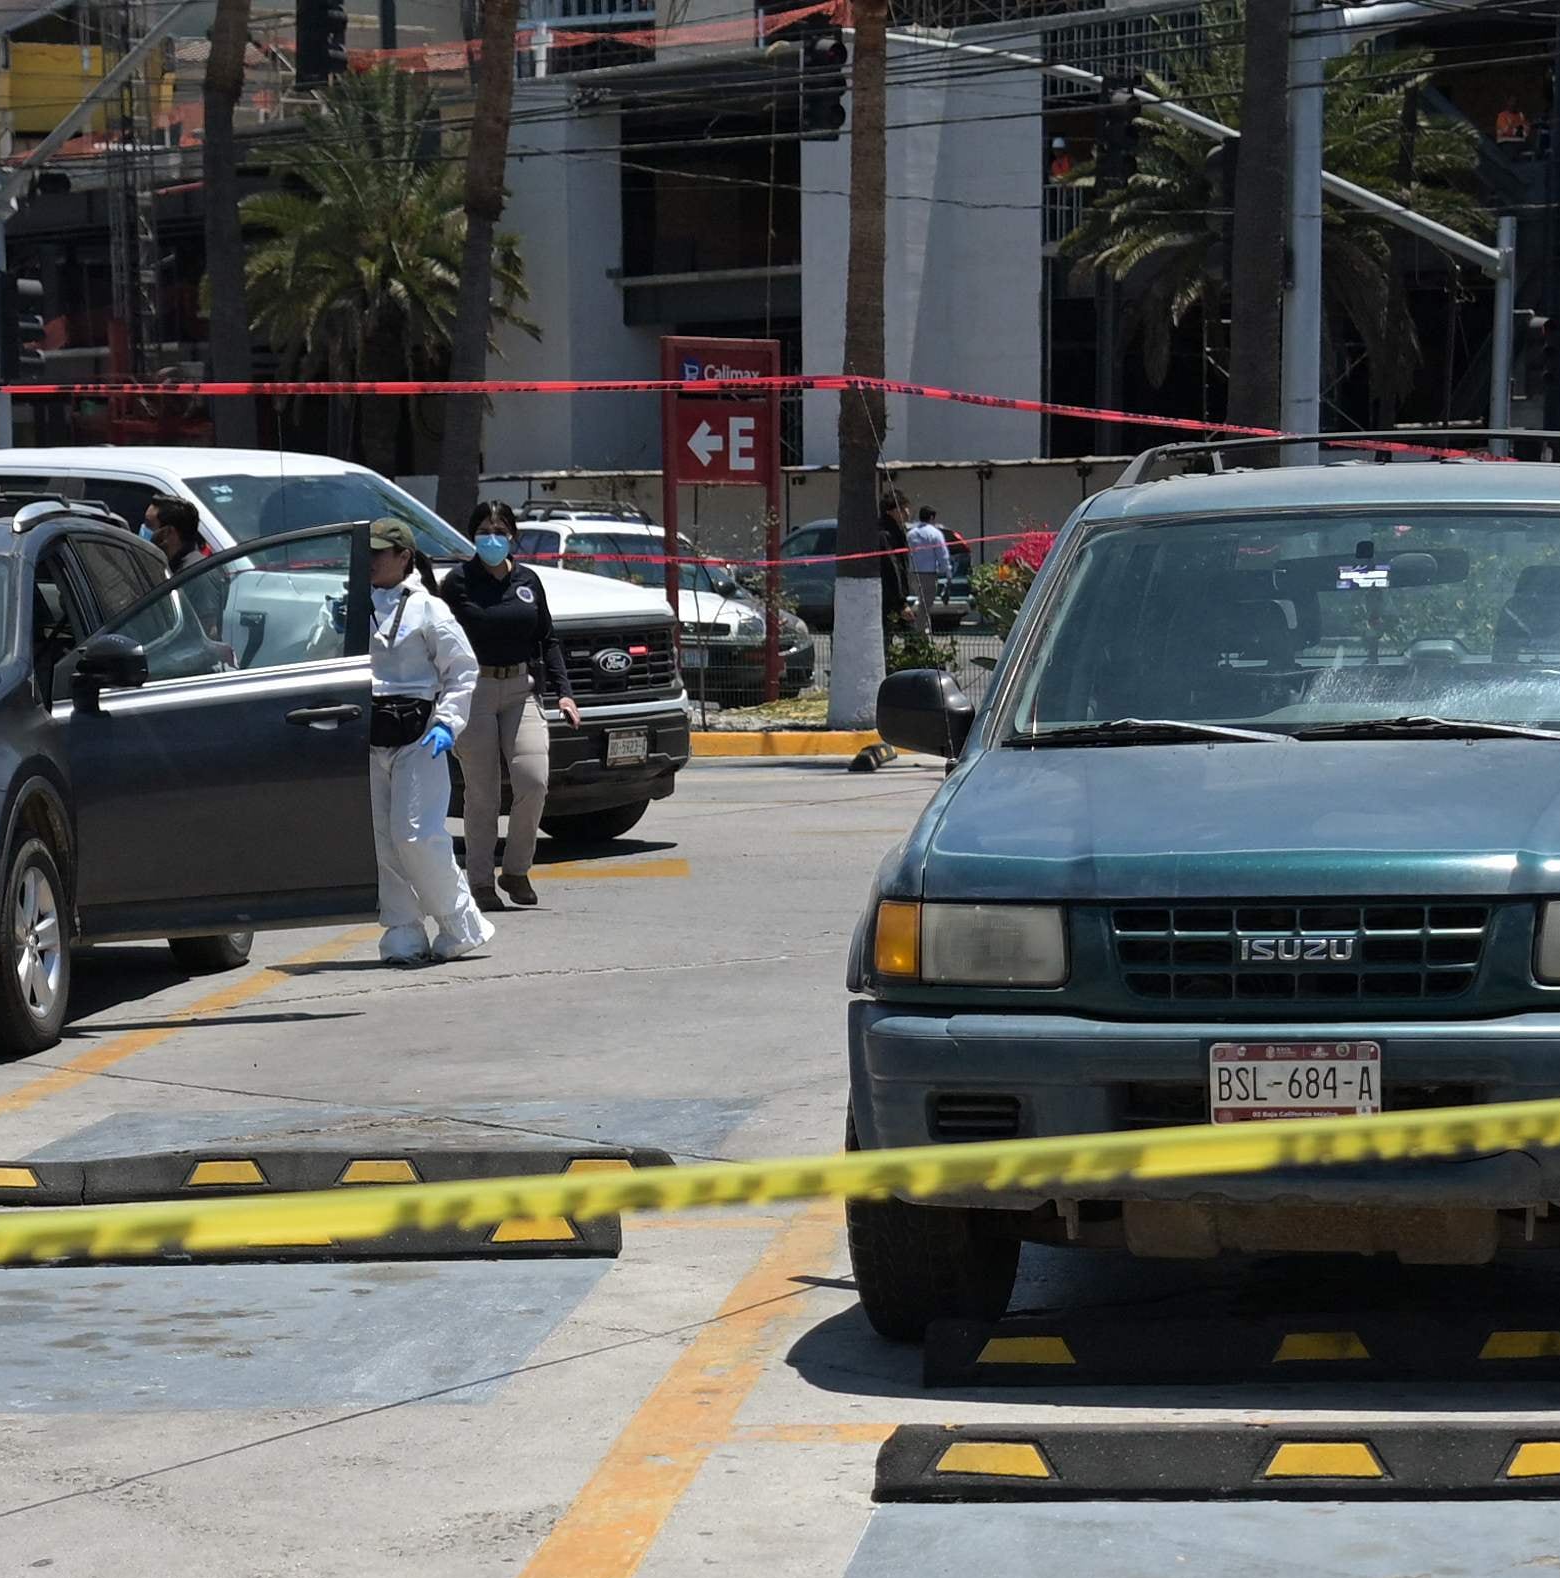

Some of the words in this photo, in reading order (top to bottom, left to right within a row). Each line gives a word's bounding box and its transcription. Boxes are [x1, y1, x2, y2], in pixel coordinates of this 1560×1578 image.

[704, 364, 760, 381] Calimax
[729, 416, 755, 471] E
[605, 655, 627, 669] Ford
[1241, 939, 1354, 961] ISUZU
[1218, 1066, 1373, 1102] BSL-684-A
[1263, 1111, 1278, 1119] Baja
